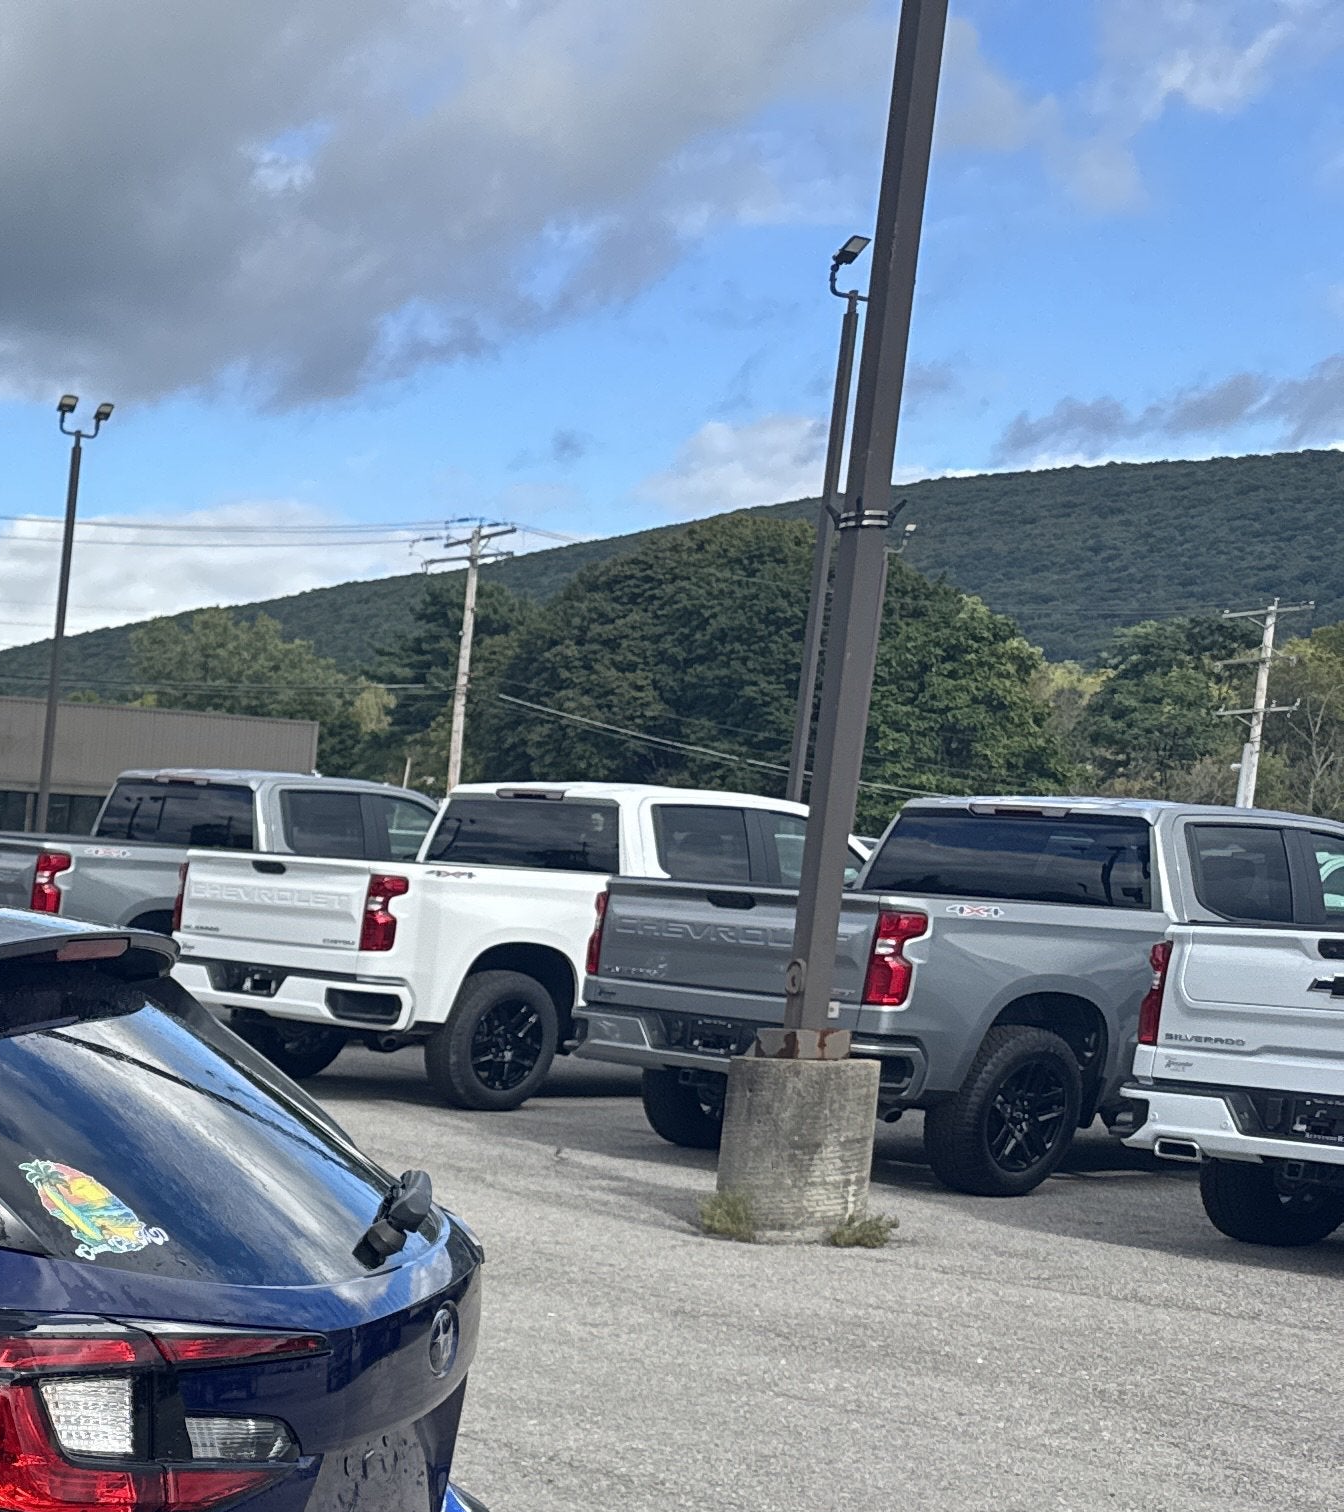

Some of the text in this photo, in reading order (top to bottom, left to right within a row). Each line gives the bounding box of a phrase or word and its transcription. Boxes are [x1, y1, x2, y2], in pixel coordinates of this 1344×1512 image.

[189, 882, 350, 910] CHEVROLET
[615, 917, 852, 949] CHEVROL
[1164, 1032, 1246, 1047] SILVERADO
